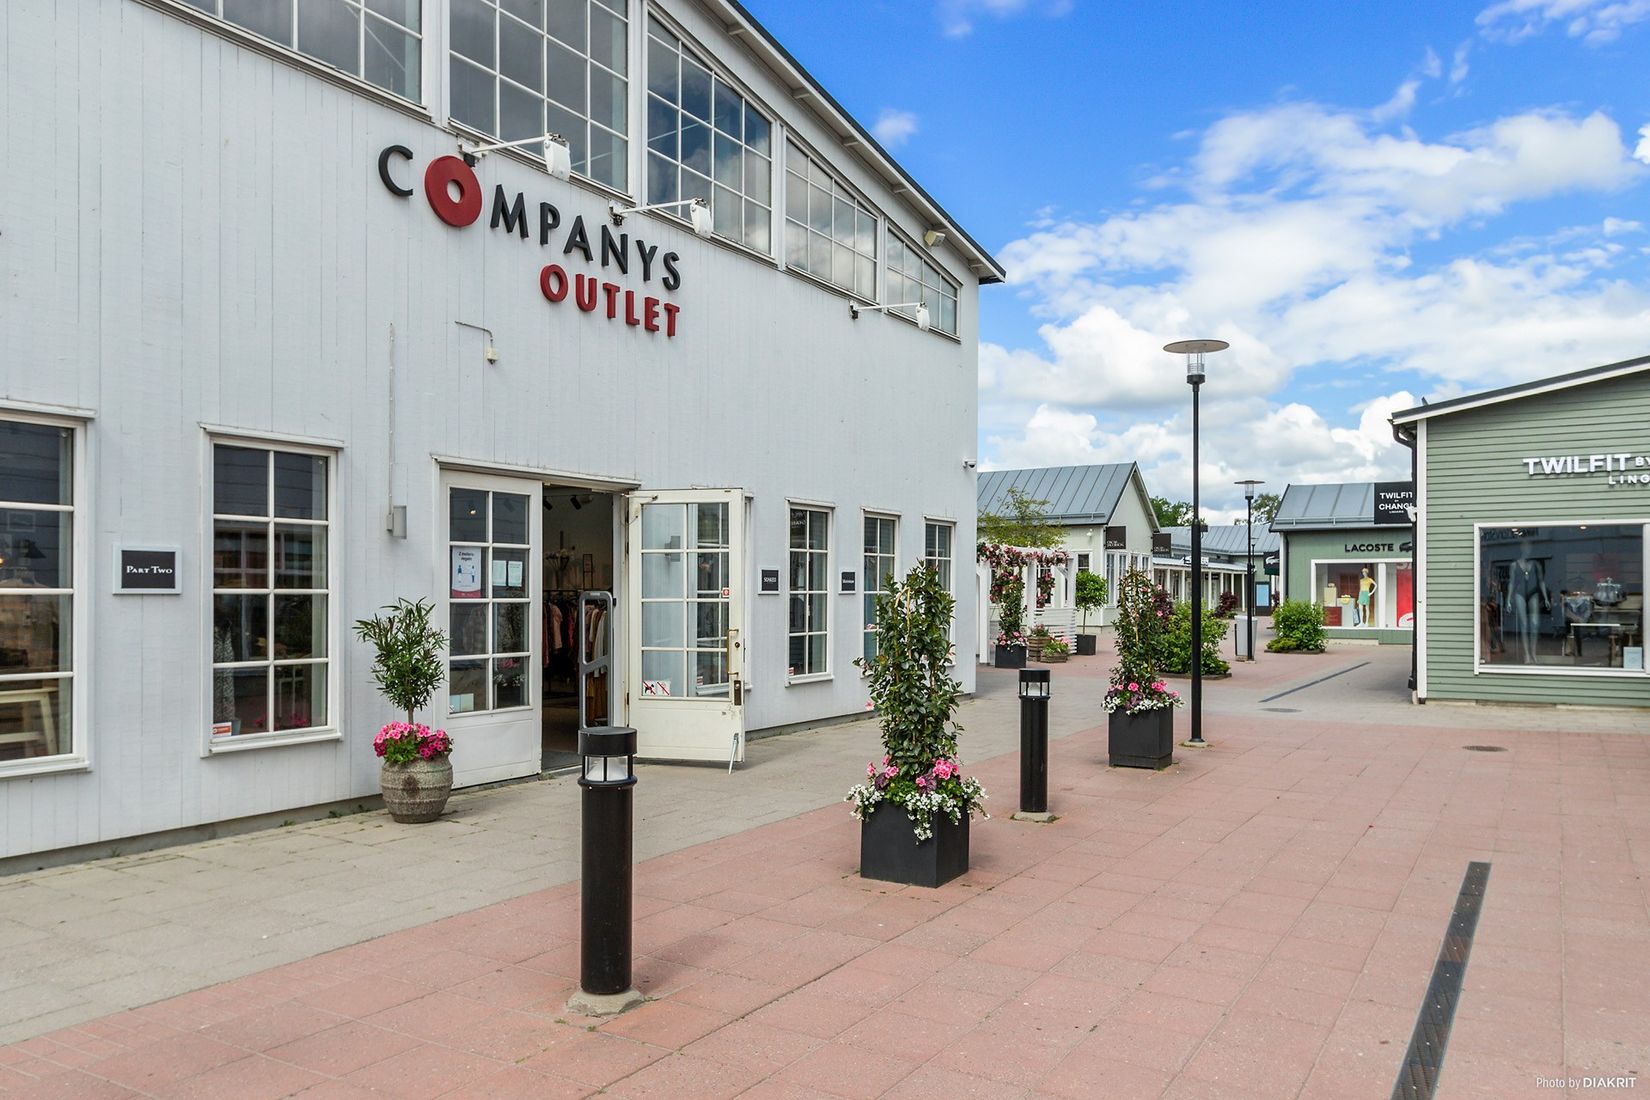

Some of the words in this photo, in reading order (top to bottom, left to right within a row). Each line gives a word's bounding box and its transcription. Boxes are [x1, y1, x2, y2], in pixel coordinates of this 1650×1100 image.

[378, 145, 681, 291] COMPANYS
[540, 264, 681, 337] OUTLET
[1522, 453, 1631, 475] TWILFIT
[1344, 543, 1395, 553] LACOSTE
